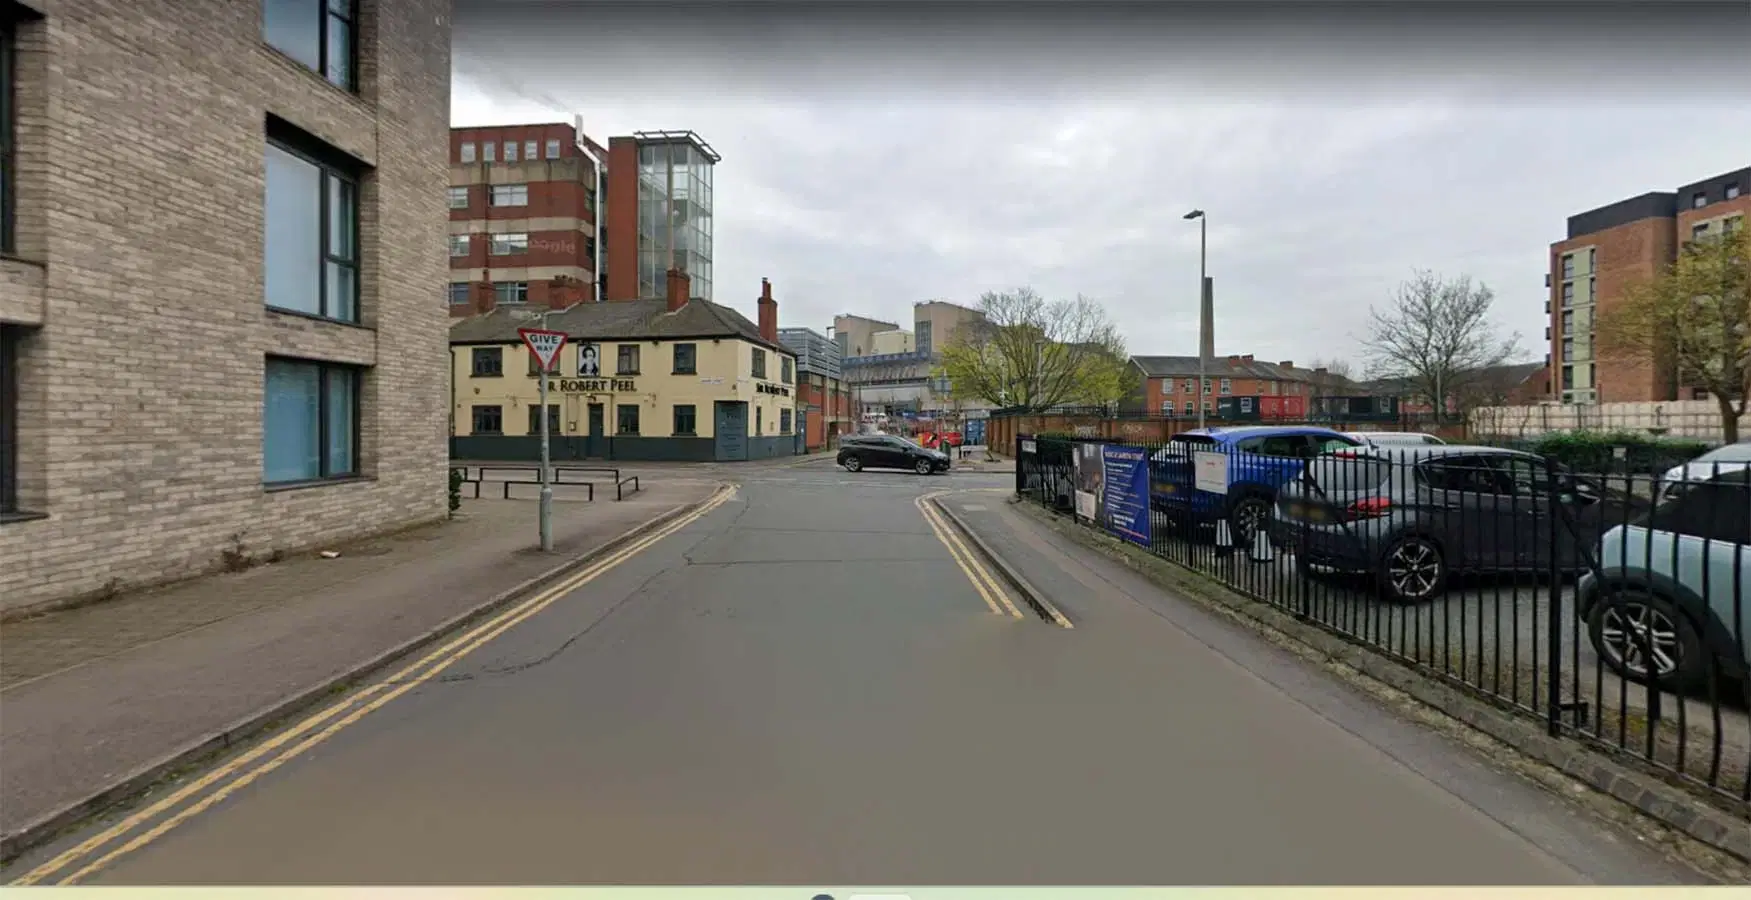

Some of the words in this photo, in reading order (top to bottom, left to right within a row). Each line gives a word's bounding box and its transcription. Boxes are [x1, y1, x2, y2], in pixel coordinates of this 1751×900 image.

[530, 334, 559, 344] GIVE
[537, 380, 556, 392] SR
[560, 379, 607, 392] ROBERT
[611, 380, 637, 392] PEEL
